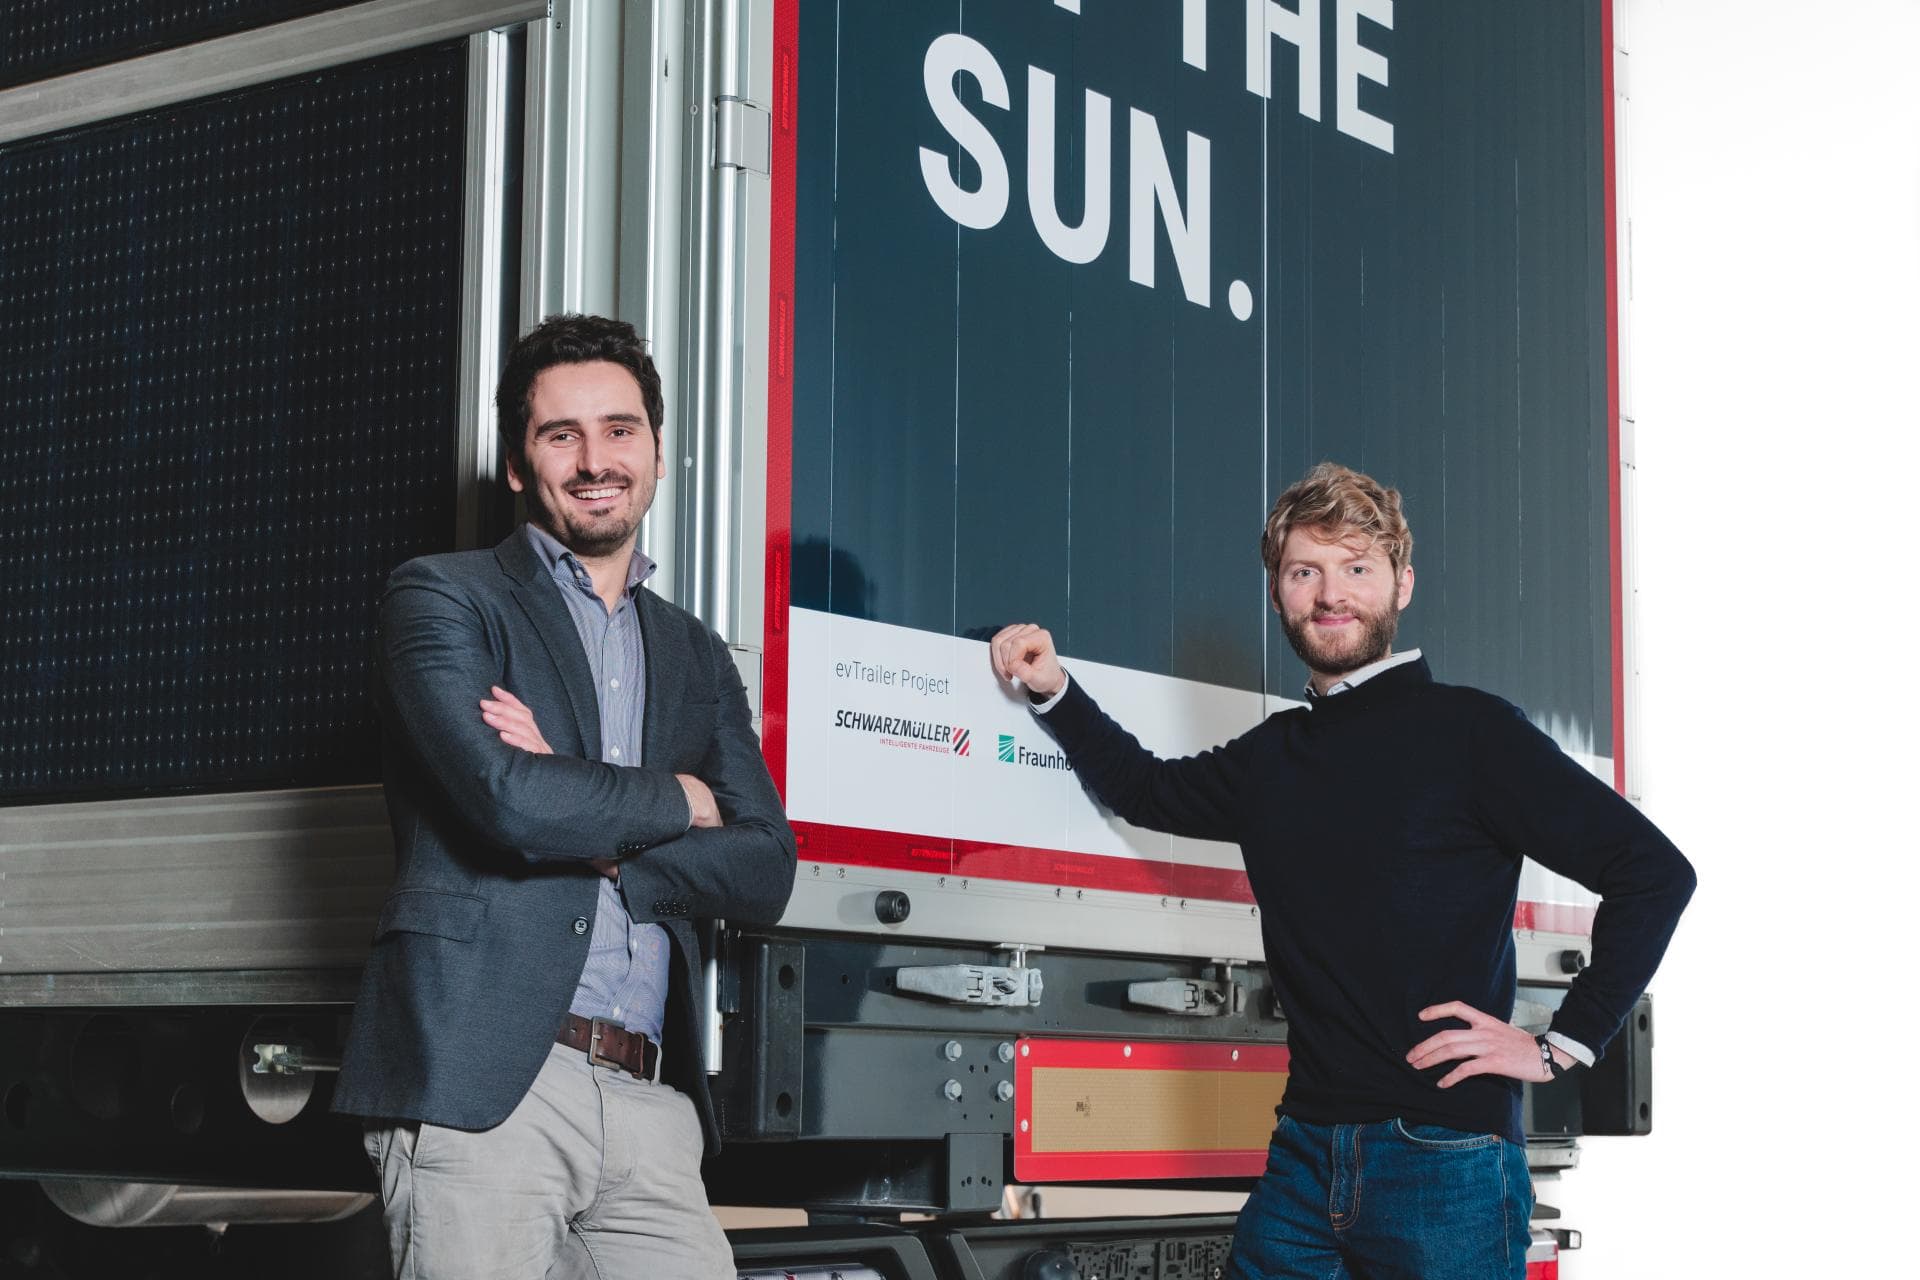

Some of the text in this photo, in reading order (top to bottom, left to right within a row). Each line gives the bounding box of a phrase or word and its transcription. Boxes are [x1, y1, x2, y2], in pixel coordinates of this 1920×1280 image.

[919, 33, 1254, 322] SUN.
[835, 660, 950, 696] evTrailer Project
[834, 709, 951, 743] SCHWARZMÜLLER
[879, 738, 950, 754] INTELLIGENTE FAHRZEUGE
[1018, 745, 1075, 772] Fraunho
